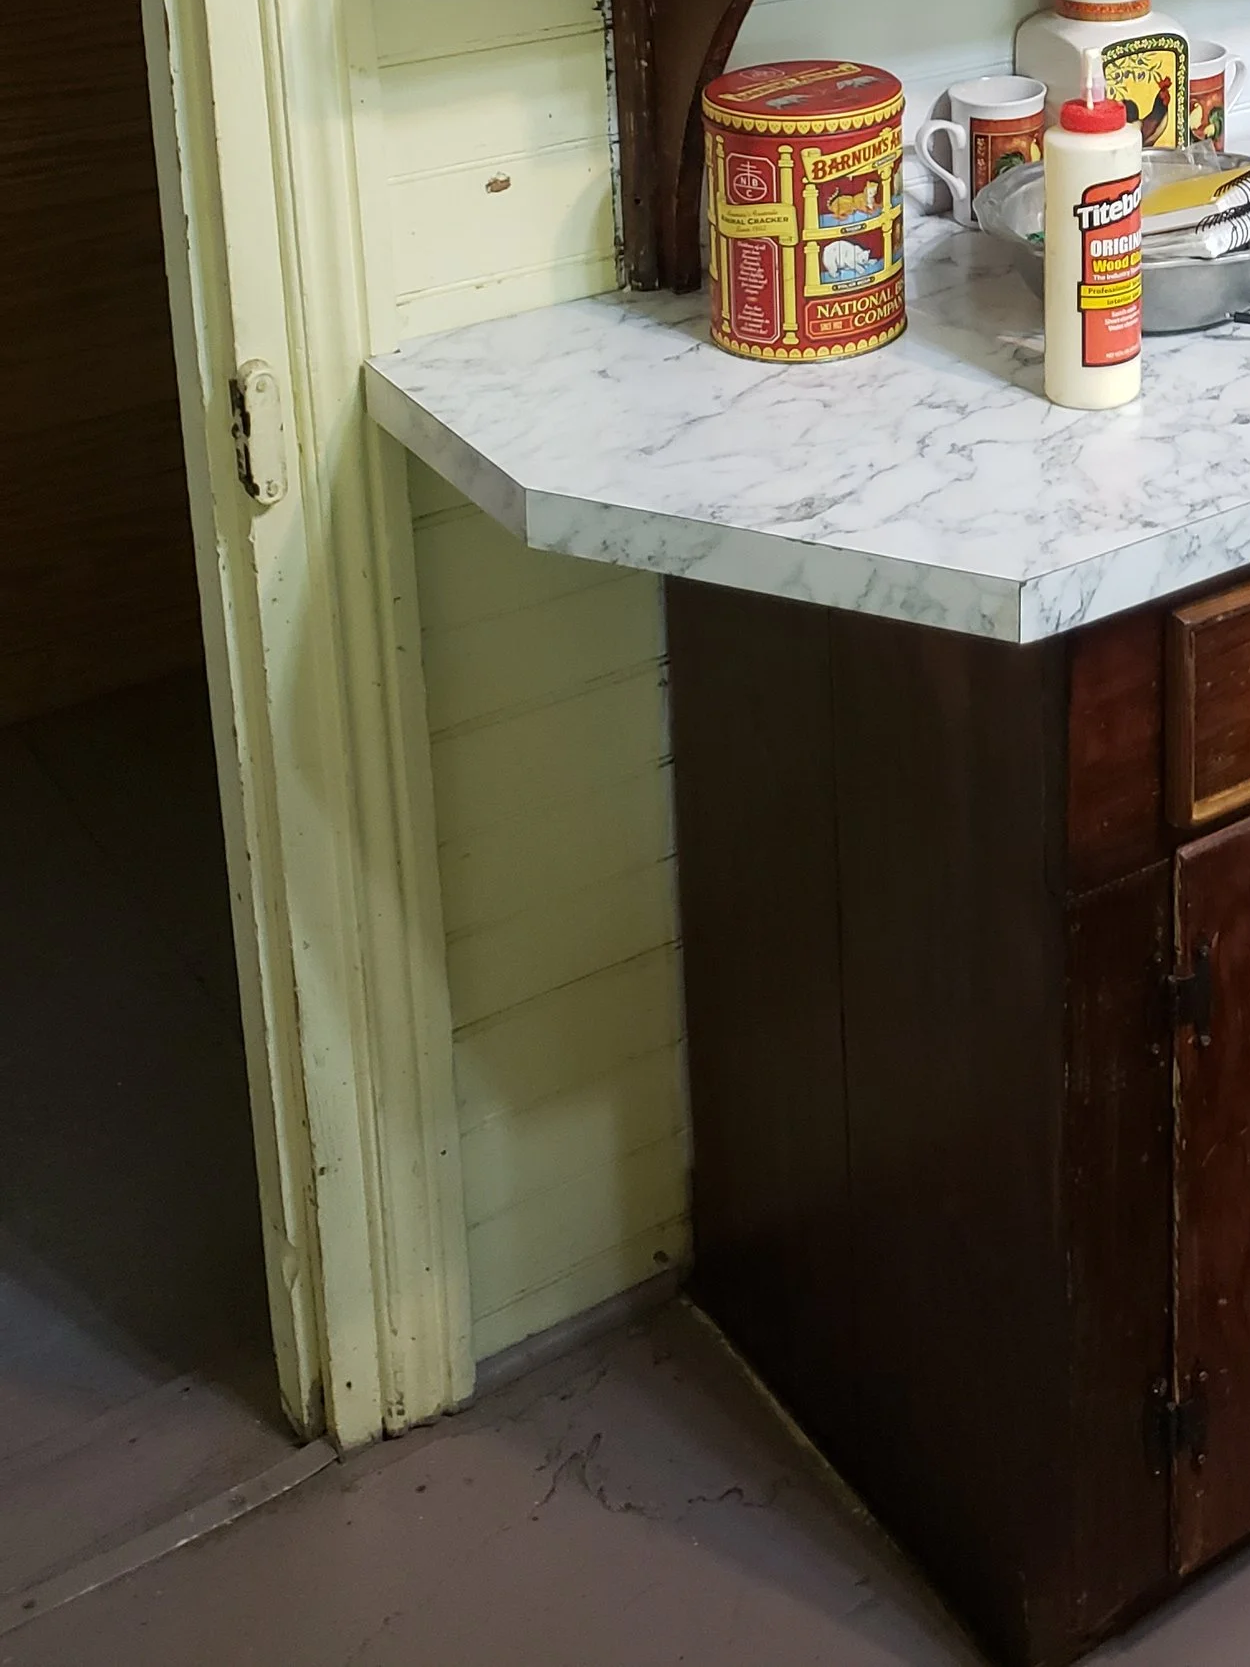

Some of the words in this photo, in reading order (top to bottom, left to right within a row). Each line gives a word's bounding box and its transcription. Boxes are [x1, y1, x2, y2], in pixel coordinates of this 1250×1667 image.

[811, 137, 889, 180] BARNUM'S
[740, 176, 747, 185] N
[751, 178, 759, 187] B
[745, 189, 753, 198] C
[747, 216, 789, 226] CRACKER
[1092, 255, 1129, 273] Wood
[816, 288, 893, 319] NATIONAL
